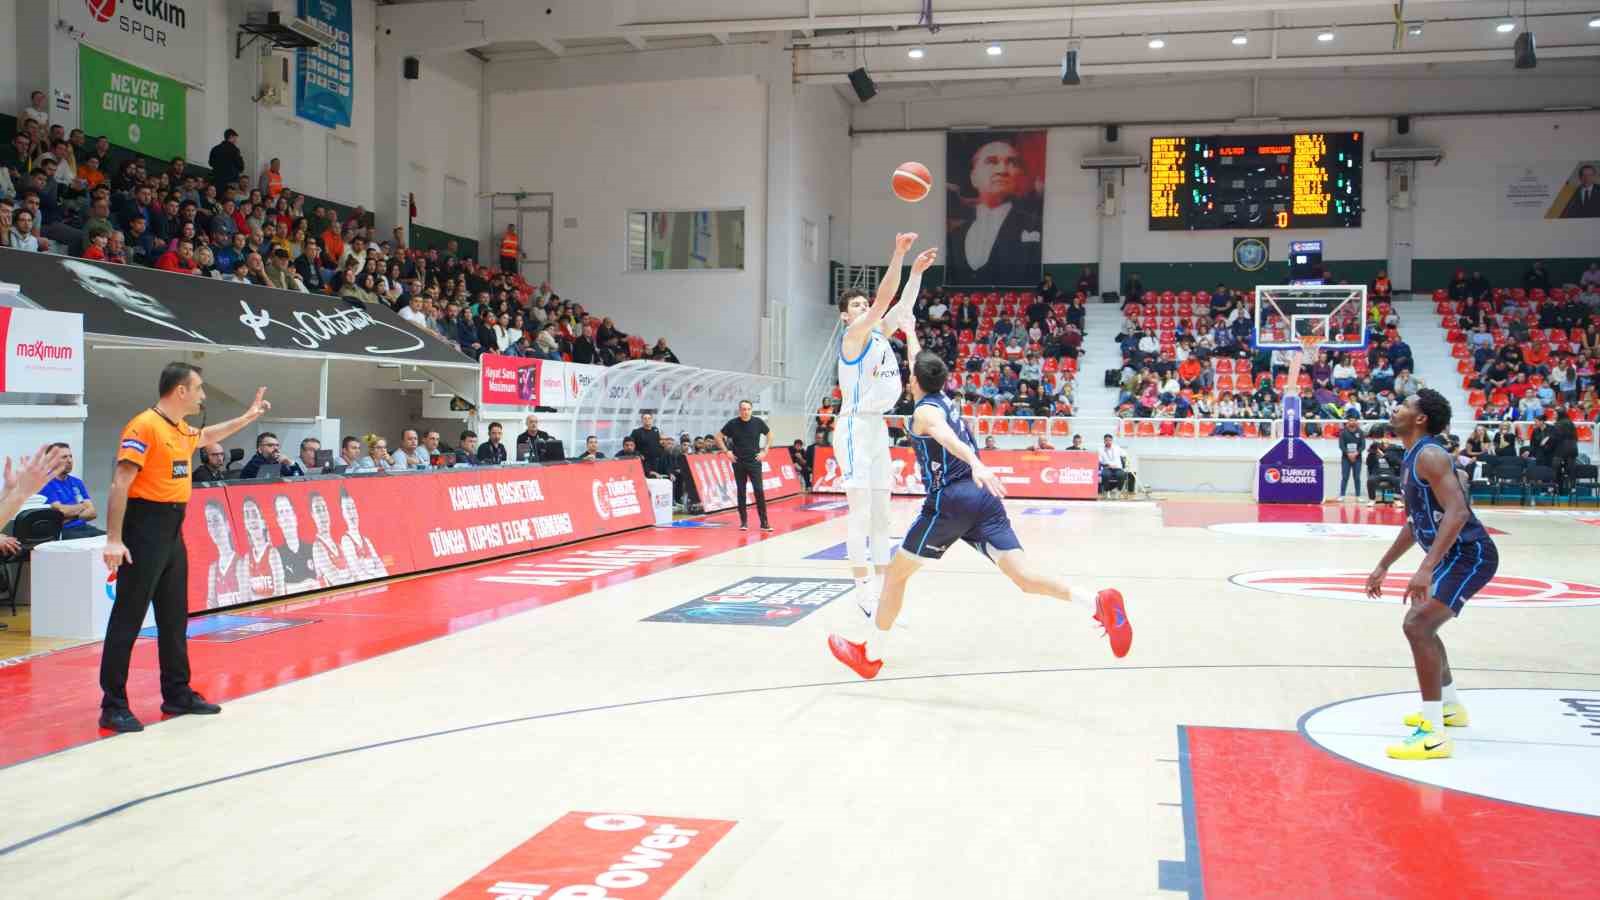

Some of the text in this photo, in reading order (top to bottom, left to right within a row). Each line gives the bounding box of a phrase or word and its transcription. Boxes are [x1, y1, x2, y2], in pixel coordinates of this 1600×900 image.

[119, 15, 168, 47] SPOR
[111, 72, 160, 100] NEVER
[102, 92, 165, 120] GIVE UP!
[429, 528, 467, 558] DÜNYA
[466, 522, 504, 552] KUPASI
[502, 518, 535, 545] ELEME
